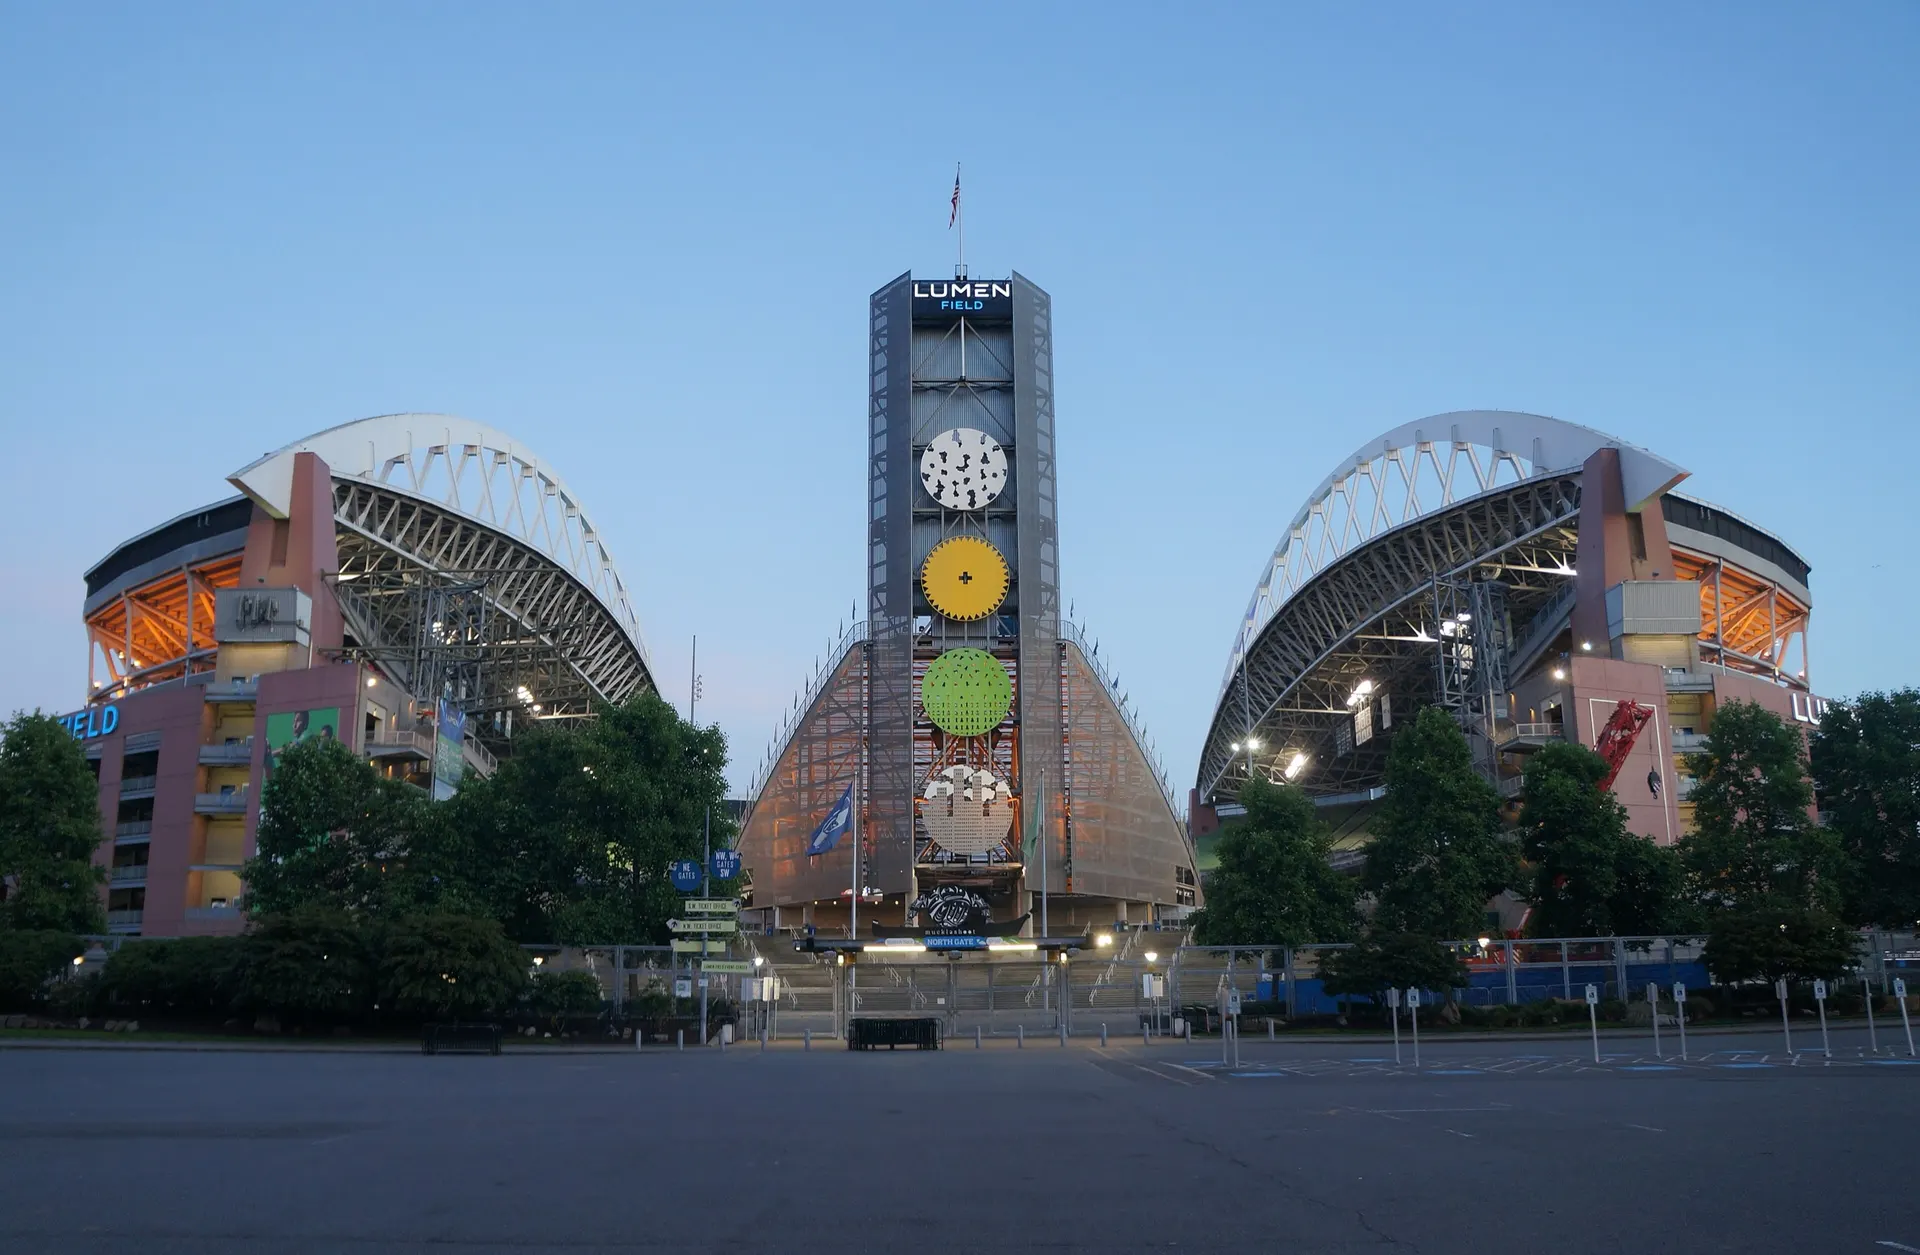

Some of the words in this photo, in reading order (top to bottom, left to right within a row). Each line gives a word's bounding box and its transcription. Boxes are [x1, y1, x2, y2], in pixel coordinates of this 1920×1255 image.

[914, 283, 1010, 298] LUMEN
[941, 301, 983, 310] FIELD
[682, 863, 691, 872] NE
[716, 861, 734, 869] GATES
[678, 872, 696, 880] GATES
[720, 868, 730, 878] SW
[927, 938, 953, 946] NORTH
[954, 938, 974, 946] GATE
